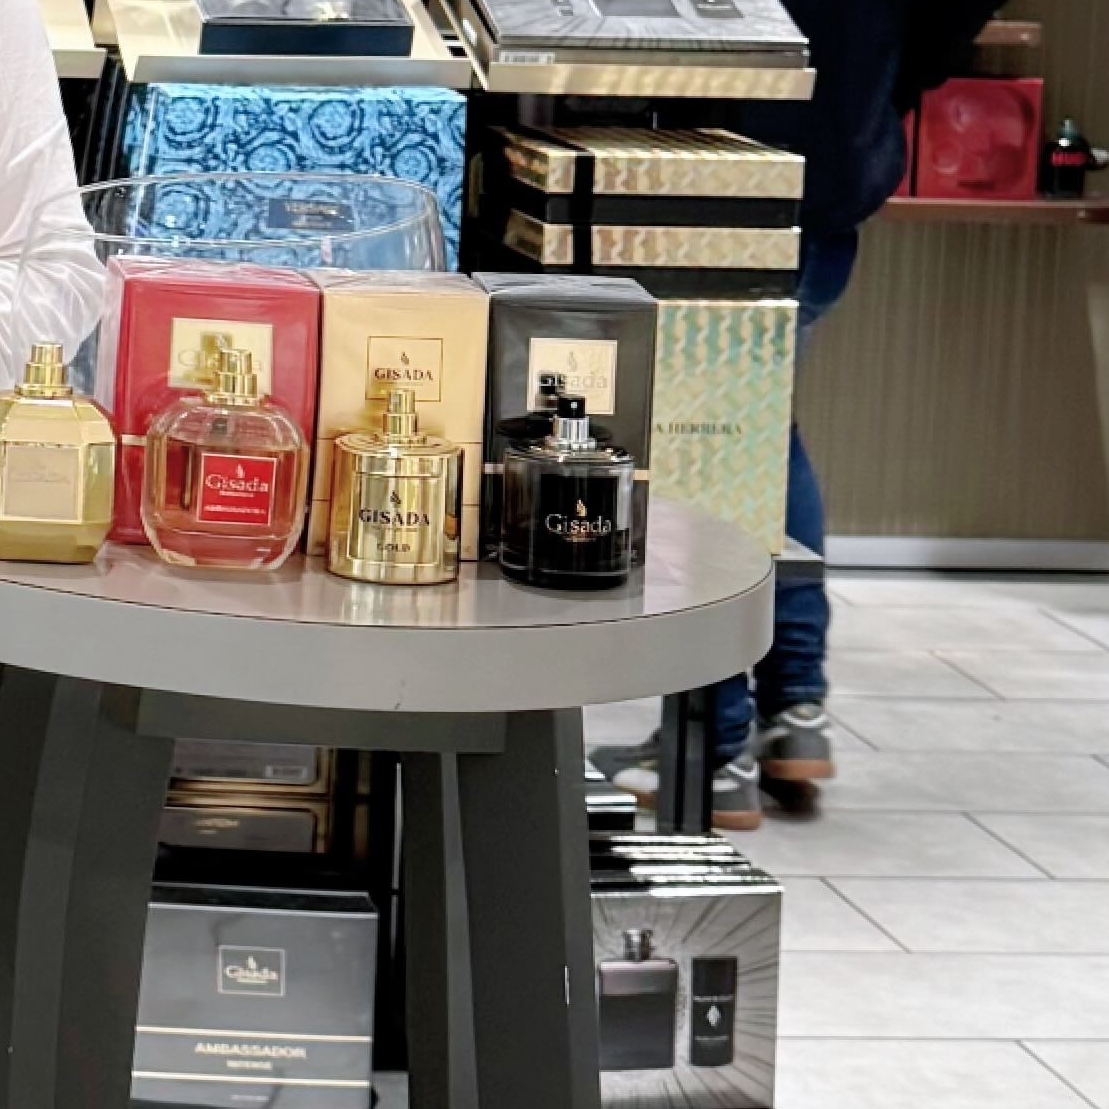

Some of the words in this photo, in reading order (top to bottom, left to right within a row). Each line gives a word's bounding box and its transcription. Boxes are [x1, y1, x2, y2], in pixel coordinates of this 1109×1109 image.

[374, 367, 433, 380] GISADA
[204, 472, 269, 492] Gisada
[358, 508, 430, 526] GISADA
[545, 513, 612, 535] Gisada
[195, 1042, 306, 1058] AMBASSADOR
